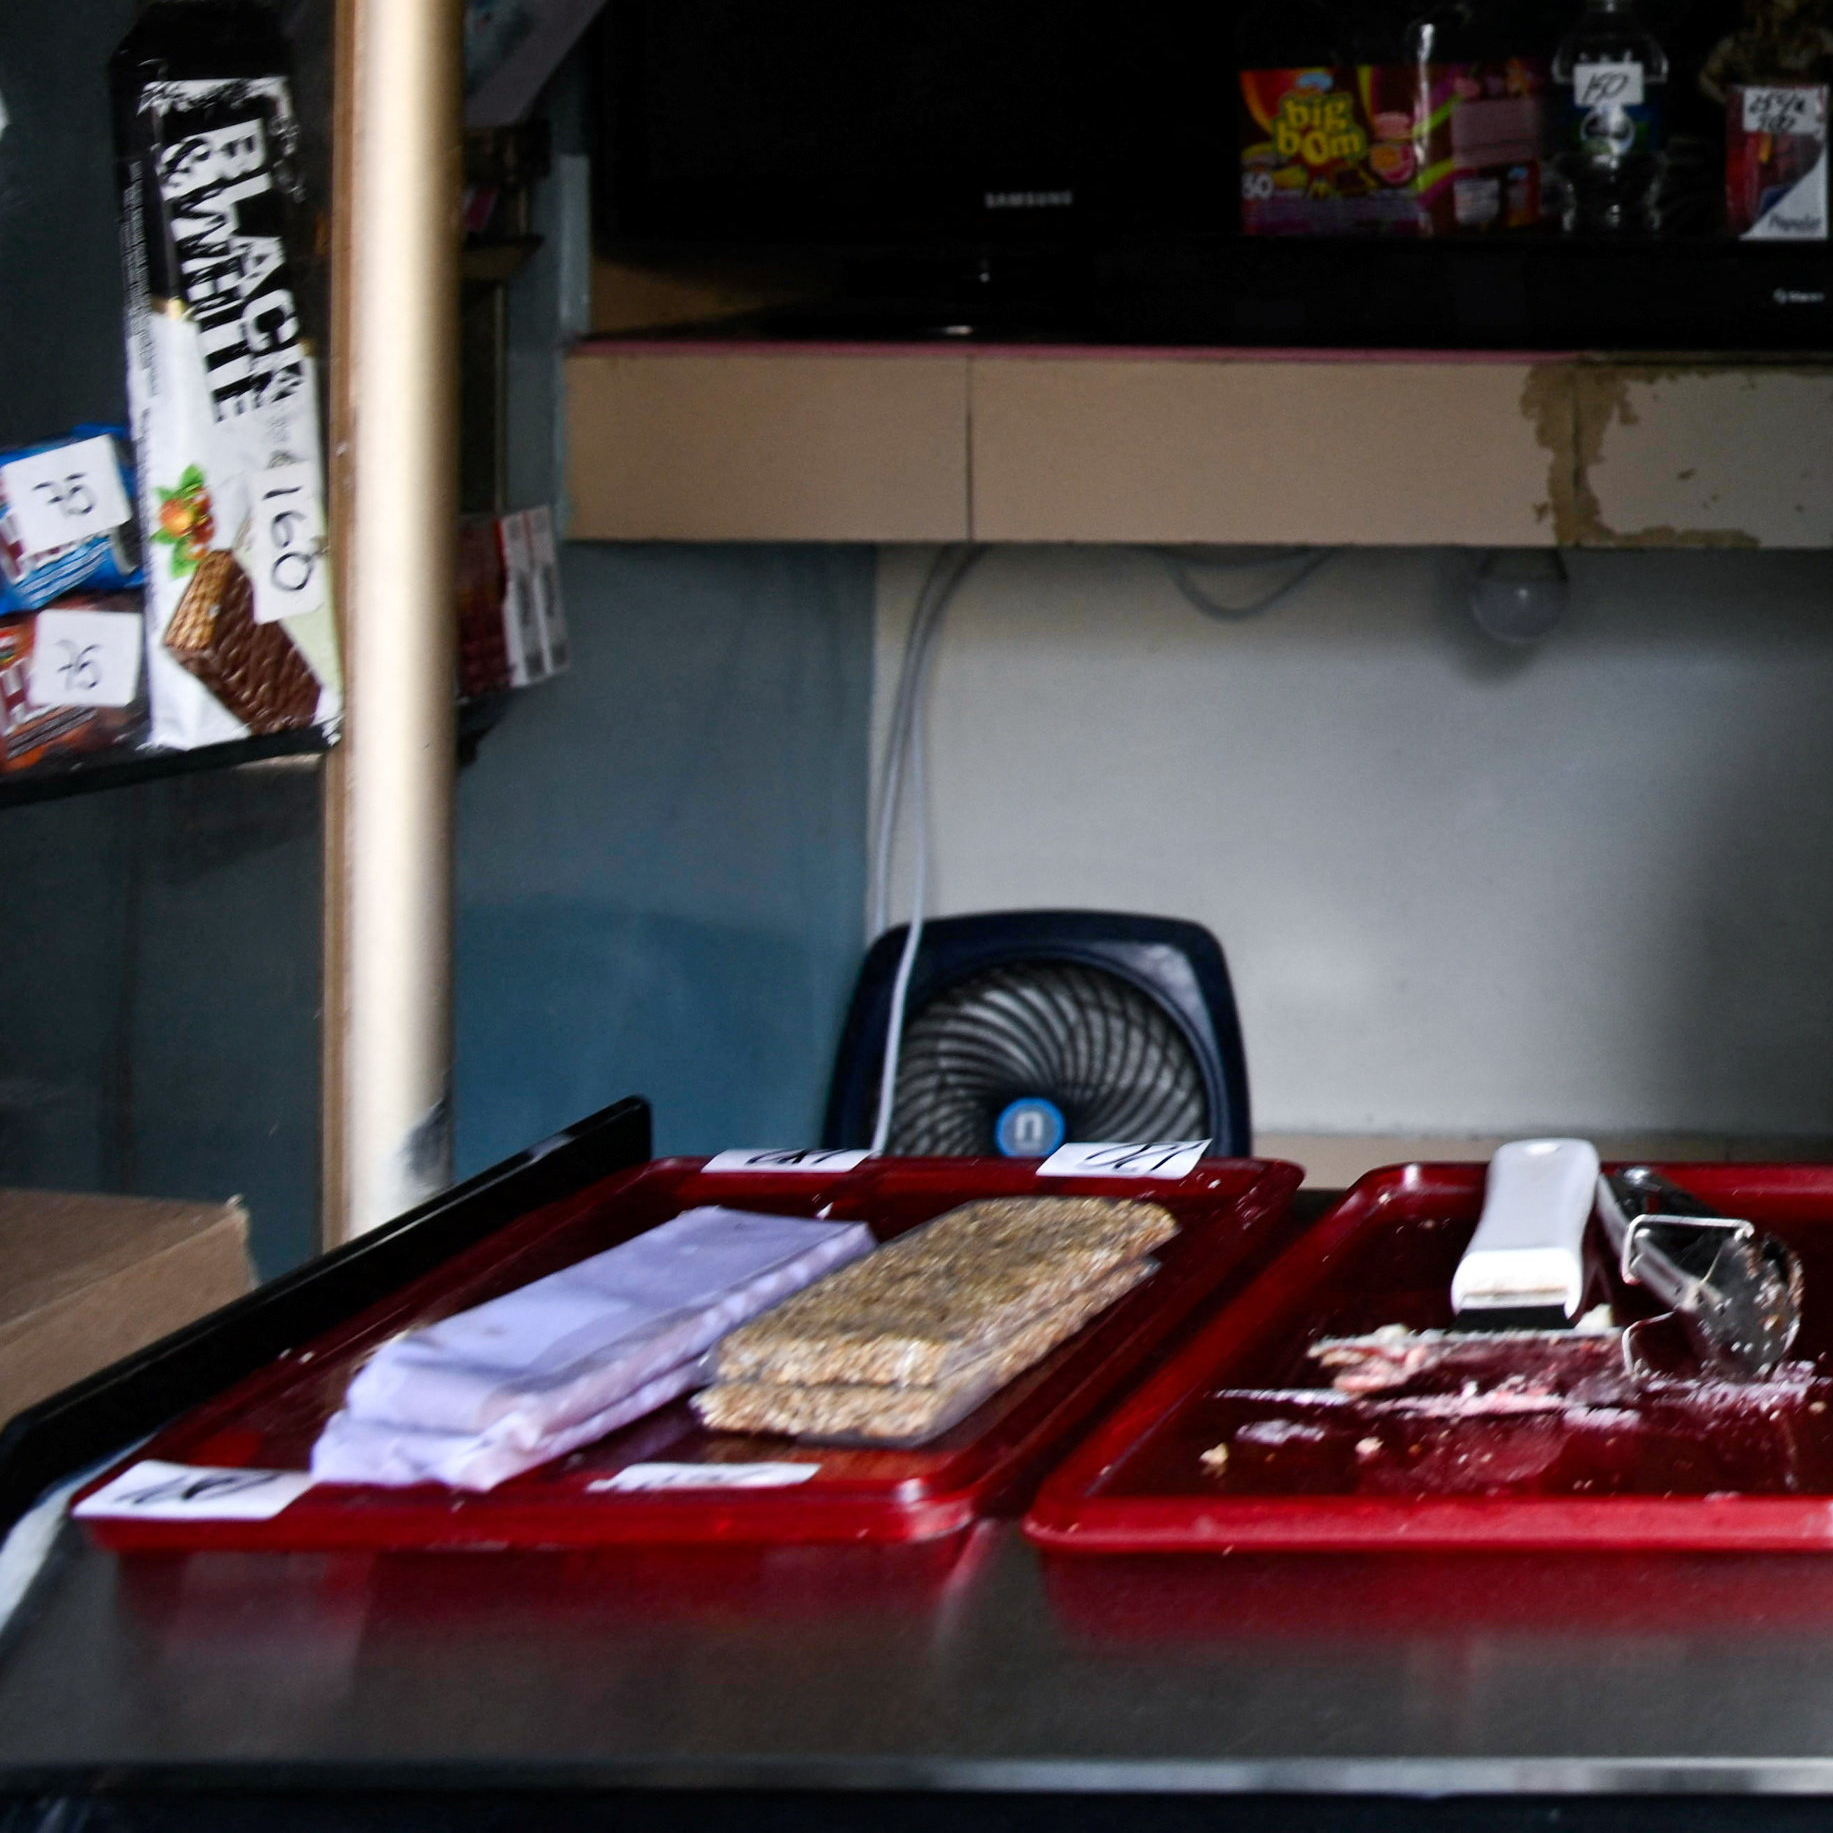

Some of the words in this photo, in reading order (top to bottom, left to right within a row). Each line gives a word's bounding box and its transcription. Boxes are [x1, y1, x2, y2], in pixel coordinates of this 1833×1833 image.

[171, 192, 256, 425] WHITE
[217, 118, 304, 403] BLACK
[261, 484, 314, 592] 160
